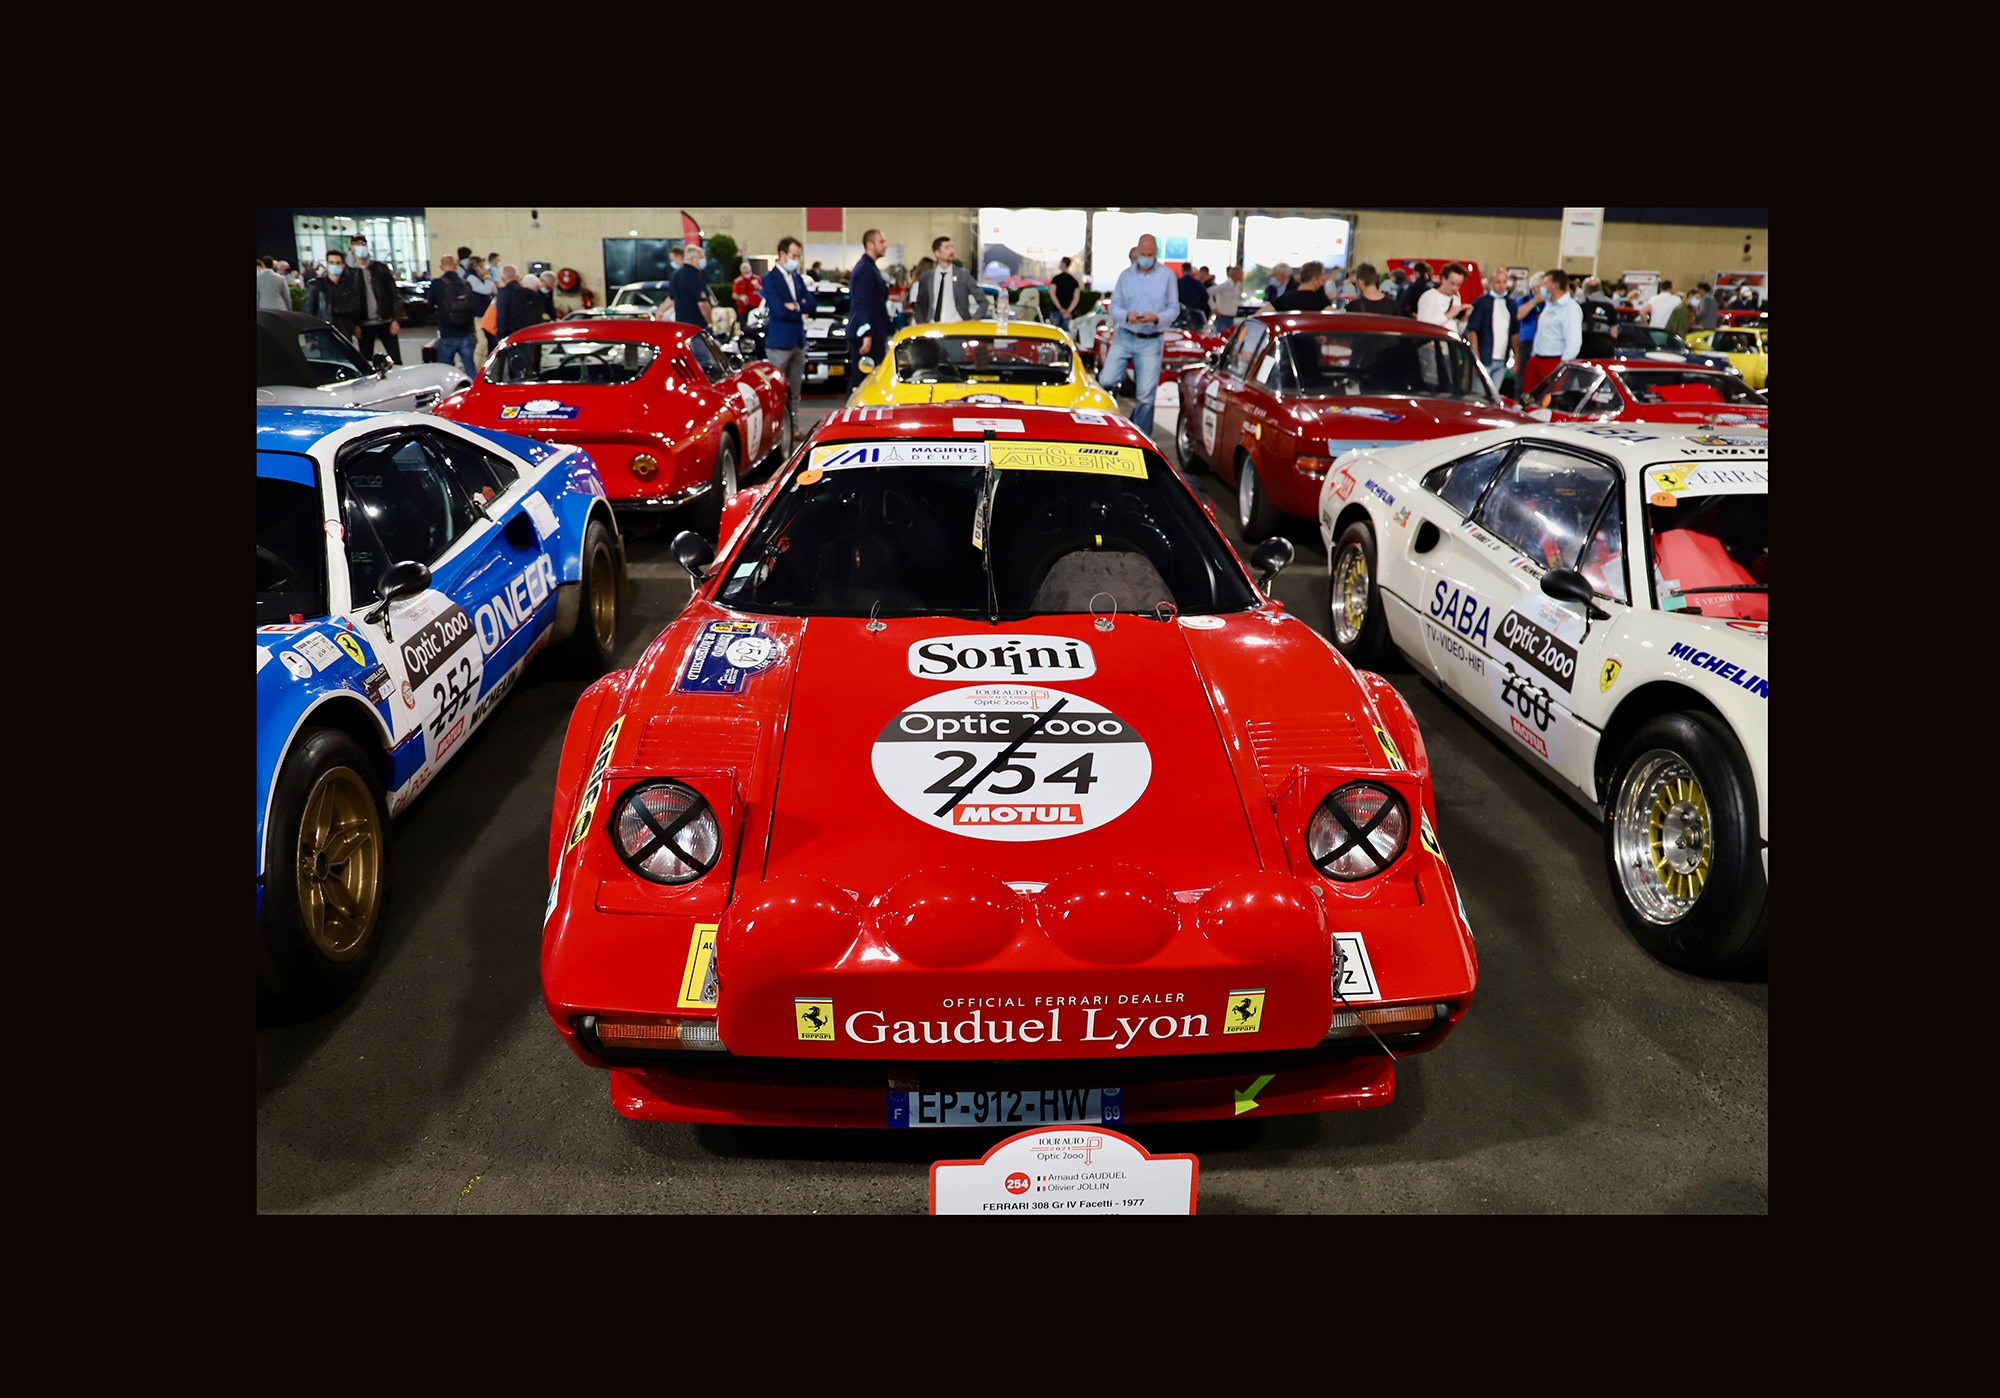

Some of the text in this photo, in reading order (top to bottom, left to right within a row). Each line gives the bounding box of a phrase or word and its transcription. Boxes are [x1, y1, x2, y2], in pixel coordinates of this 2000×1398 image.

[1364, 478, 1396, 507] MICHELIN
[474, 553, 557, 655] ONEER
[1430, 580, 1490, 648] SABA
[404, 611, 469, 676] Optic 2000
[734, 640, 762, 663] 254
[918, 640, 1085, 675] Sorini
[1426, 622, 1486, 677] TV-VIDEO-HIFI
[1503, 613, 1575, 679] Optic 2000
[1667, 641, 1768, 700] MICHELIN
[432, 657, 474, 740] 252
[469, 667, 519, 730] MICHELIN
[1501, 662, 1554, 733] 260
[899, 713, 1123, 740] Optic 2000
[1513, 719, 1547, 754] MOTUL
[923, 750, 1098, 795] 254
[958, 806, 1077, 823] MOTUL
[943, 992, 1186, 1008] OFFICIAL FERRARI DEALER
[801, 1032, 832, 1040] Ferrari
[845, 1007, 1210, 1050] Gauduel Lyon
[1226, 1025, 1257, 1033] Ferrari
[894, 1108, 903, 1120] F
[918, 1090, 1091, 1124] EP-912-HW
[1104, 1105, 1121, 1121] 69
[1038, 1136, 1085, 1146] TOUR AUTO
[1036, 1151, 1085, 1162] Optic 2000
[1006, 1178, 1030, 1190] 254
[1047, 1171, 1127, 1181] Arnaud GAUDUEL
[1047, 1182, 1110, 1192] Olivier JOLLIN
[982, 1202, 1030, 1211] FERRARI
[1031, 1201, 1050, 1210] 308
[1051, 1200, 1065, 1209] Gr
[1066, 1200, 1077, 1208] IV
[1079, 1199, 1113, 1208] Facetti
[1122, 1198, 1145, 1207] 1977
